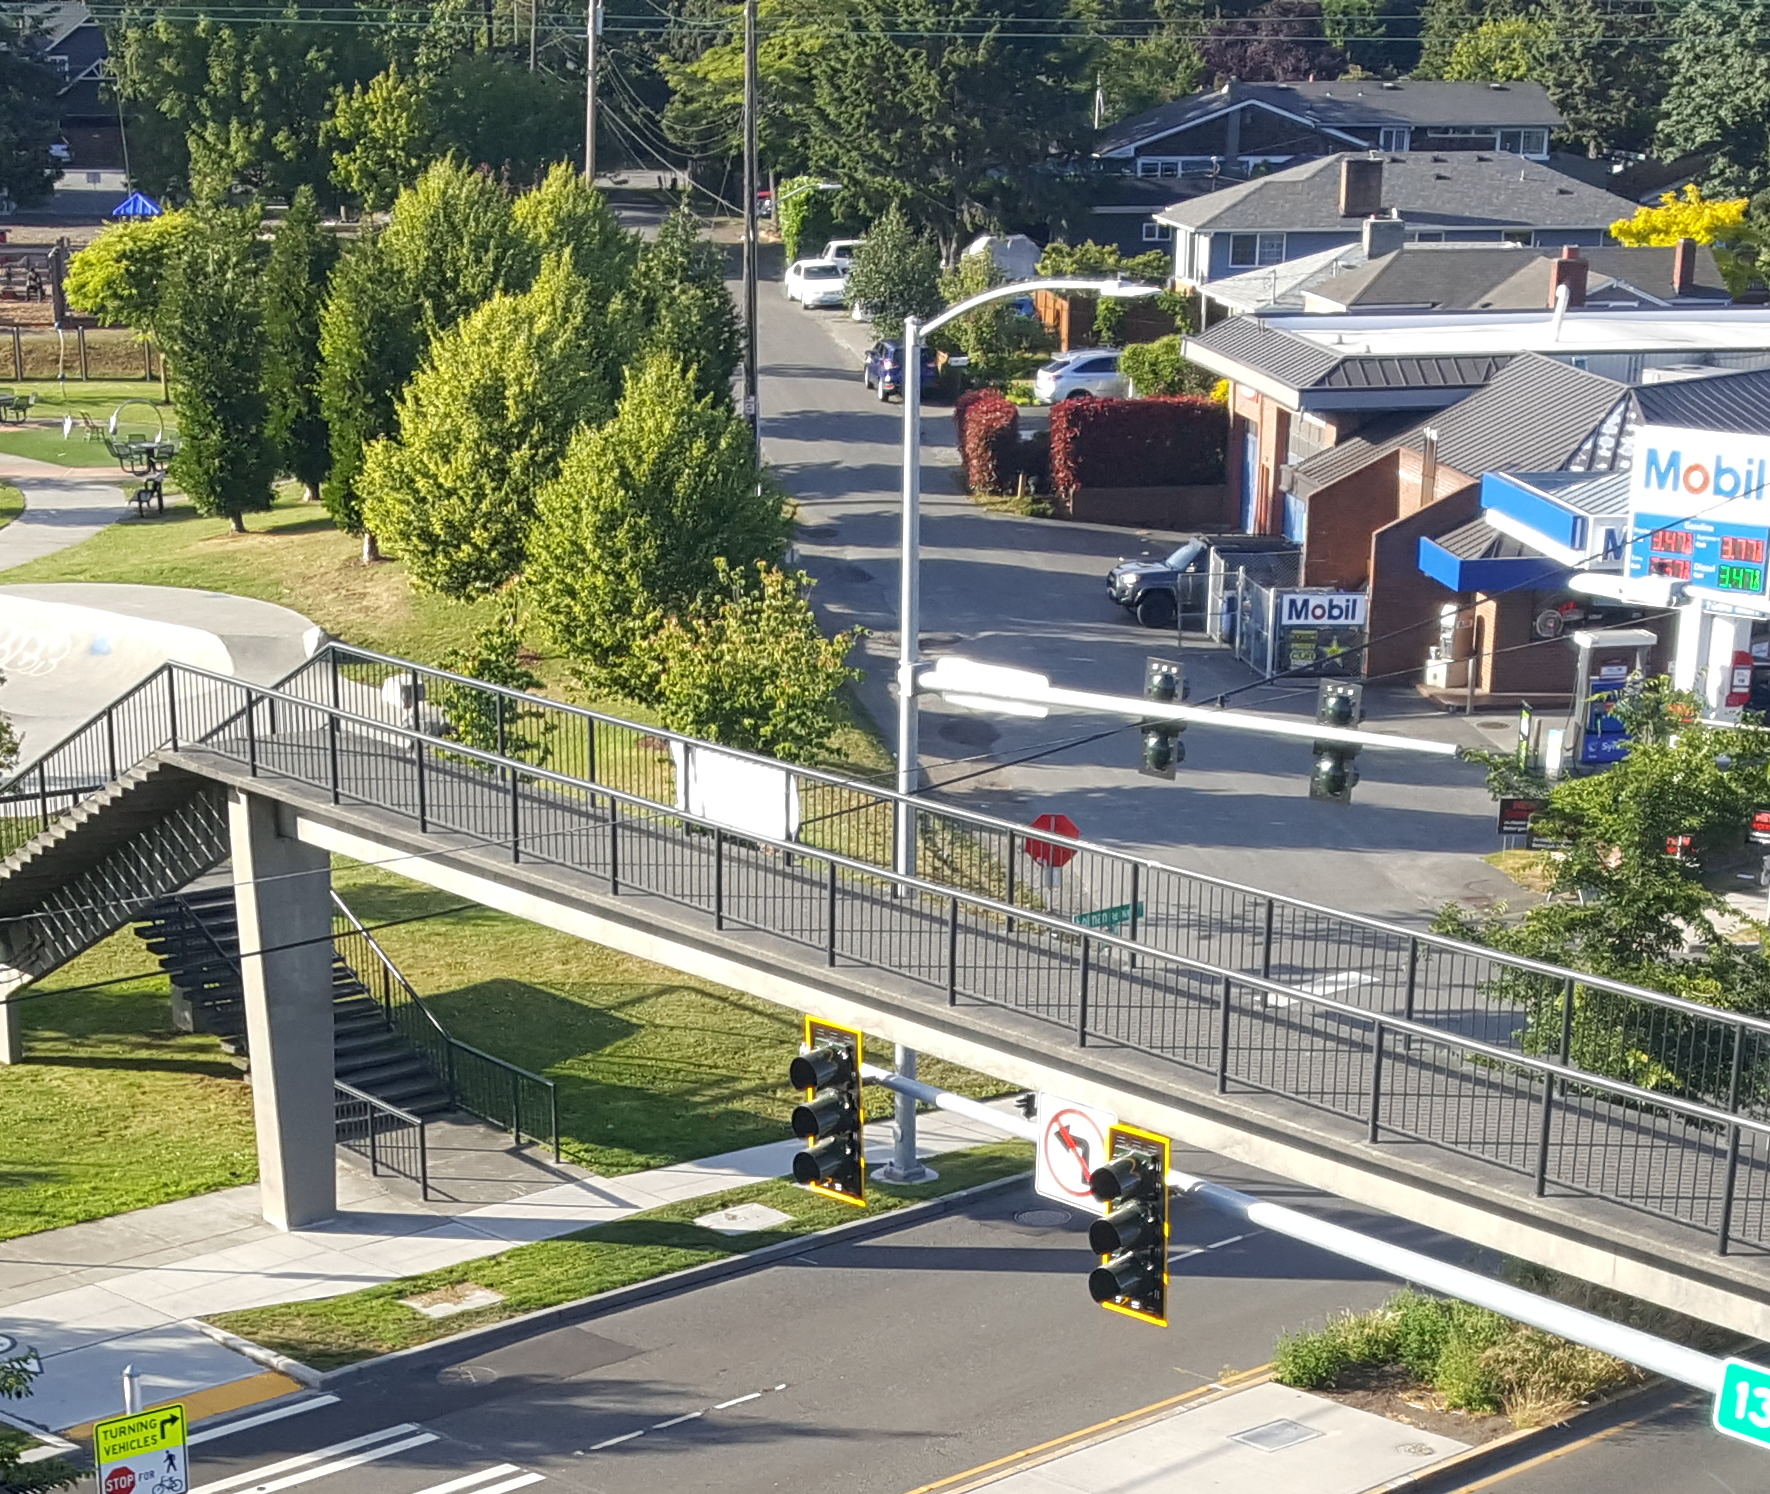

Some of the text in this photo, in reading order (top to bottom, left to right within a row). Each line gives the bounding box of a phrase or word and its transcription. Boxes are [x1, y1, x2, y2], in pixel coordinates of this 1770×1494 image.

[1644, 448, 1766, 500] Mobil
[1288, 598, 1358, 620] Mobil
[103, 1419, 157, 1440] TURNING
[104, 1435, 158, 1456] VEHICLES
[106, 1470, 156, 1492] STOP FOR
